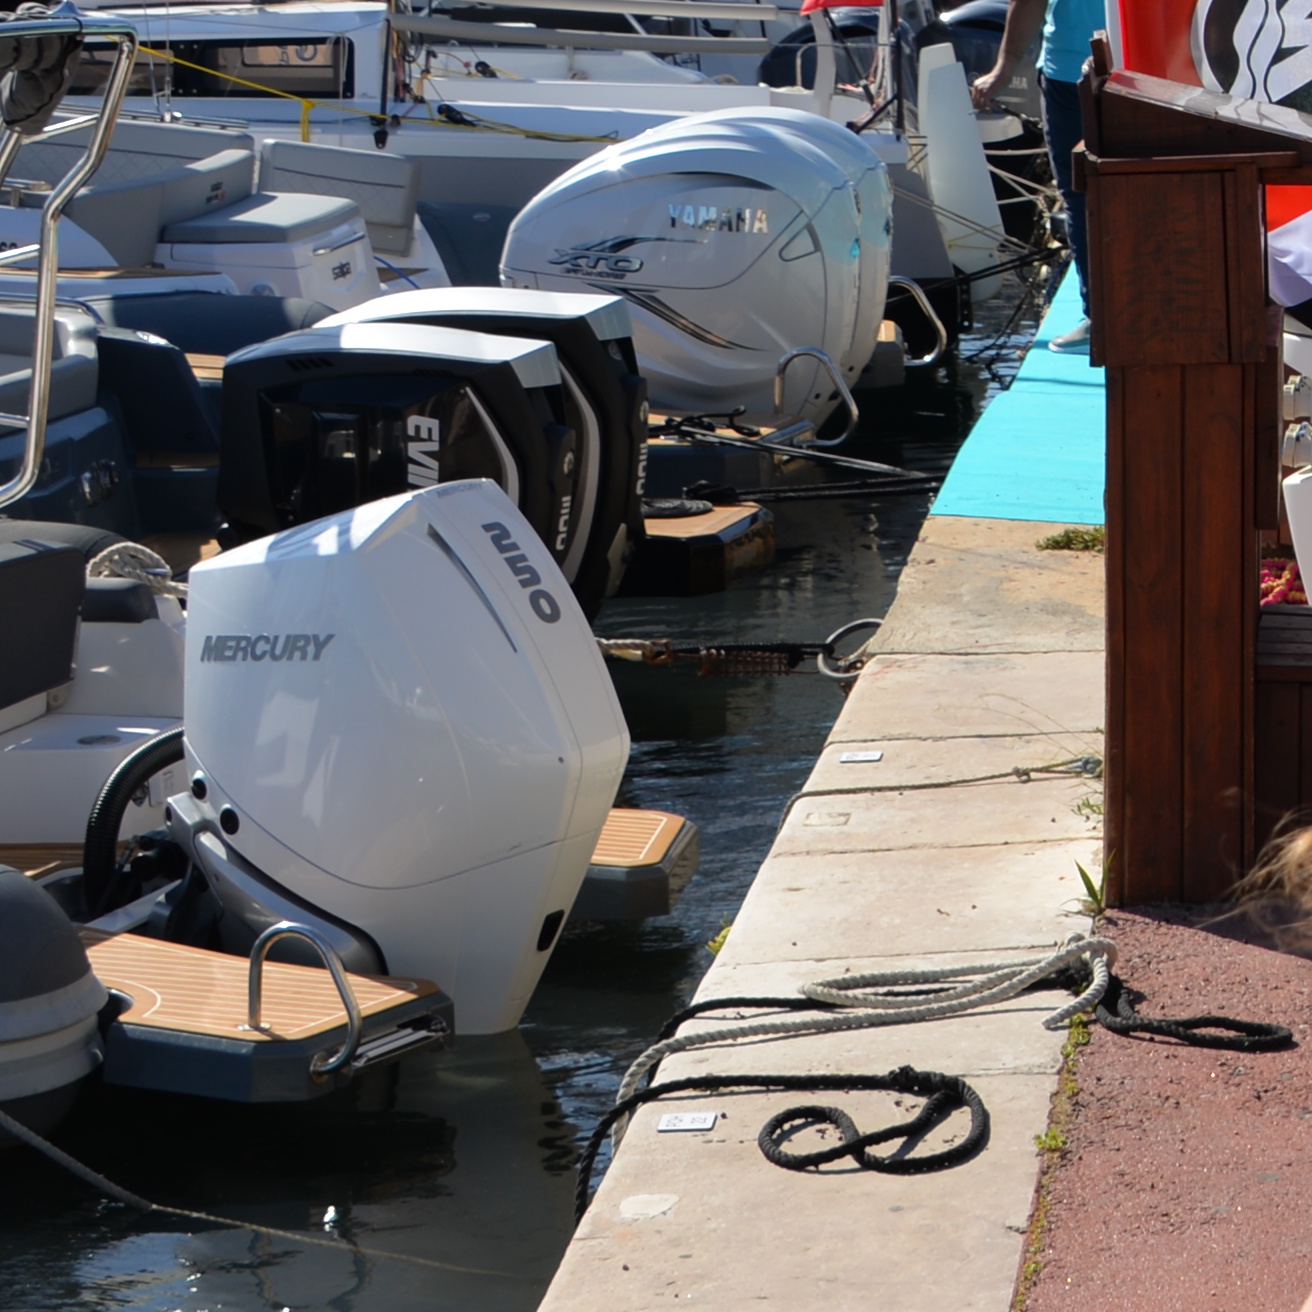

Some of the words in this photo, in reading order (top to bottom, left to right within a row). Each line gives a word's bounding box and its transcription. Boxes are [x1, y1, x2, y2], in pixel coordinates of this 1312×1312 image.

[668, 203, 769, 234] YAMAHA
[547, 248, 644, 273] XTO
[200, 633, 336, 663] MERCURY
